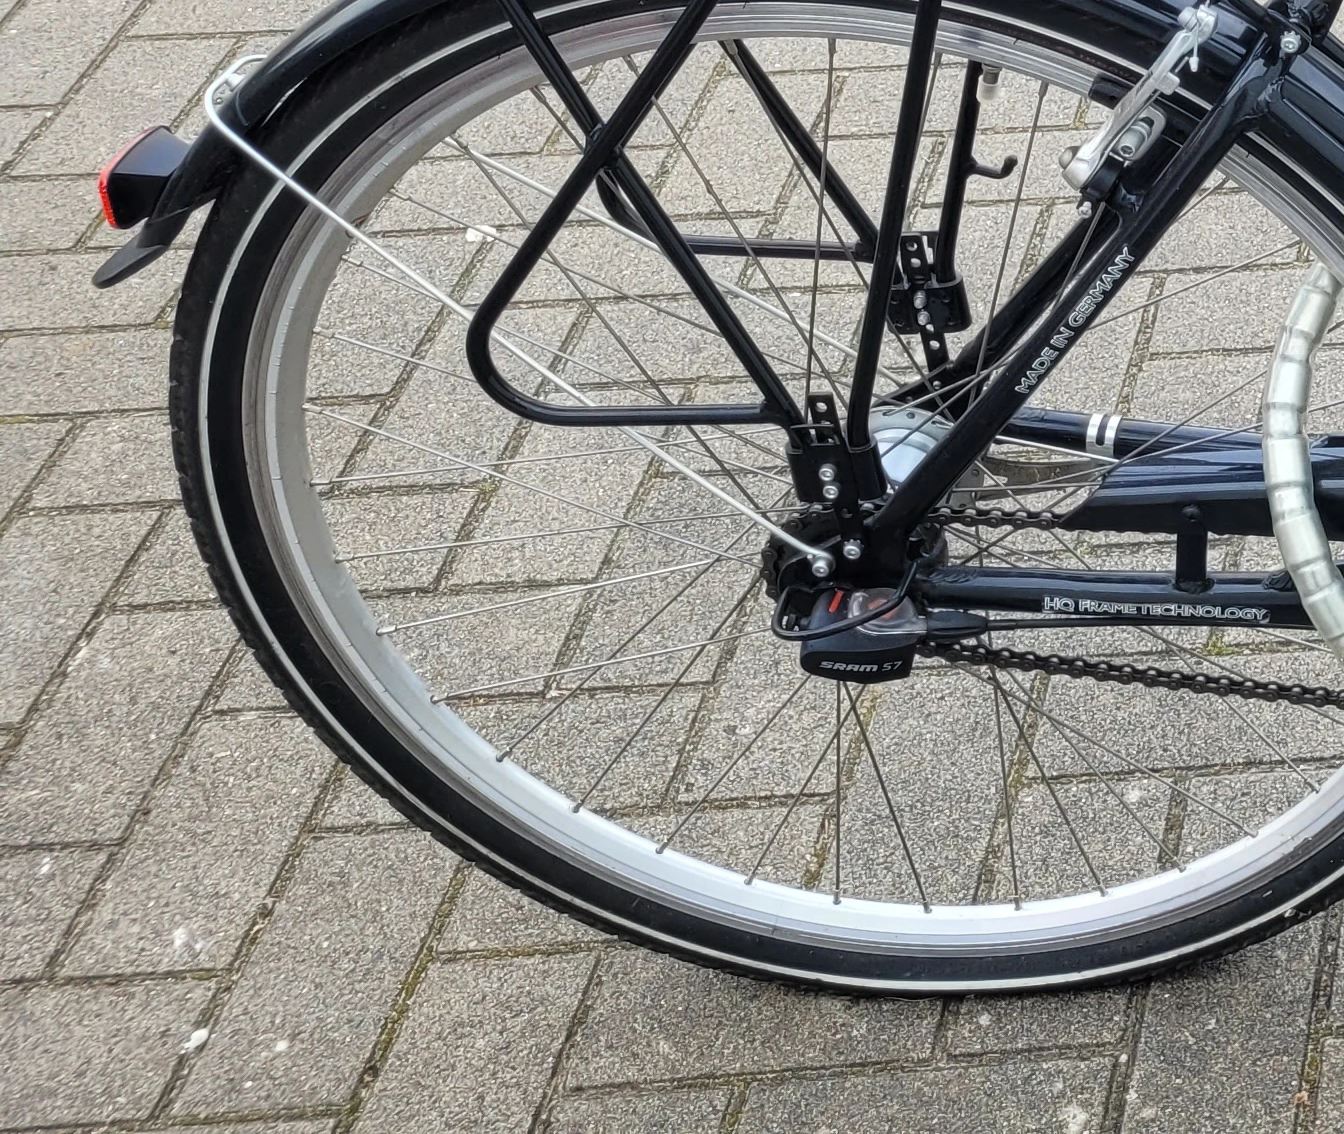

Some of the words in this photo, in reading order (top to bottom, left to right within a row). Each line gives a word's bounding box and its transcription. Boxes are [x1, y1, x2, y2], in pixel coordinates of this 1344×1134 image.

[1014, 346, 1058, 394] MADE
[1051, 326, 1075, 351] IN
[1068, 246, 1136, 328] GERMANY
[1044, 596, 1075, 612] HQ
[1079, 598, 1137, 615] FRAME
[1139, 602, 1268, 621] TECHNOLOGY
[819, 660, 879, 673] SRAM
[881, 660, 903, 672] S7
